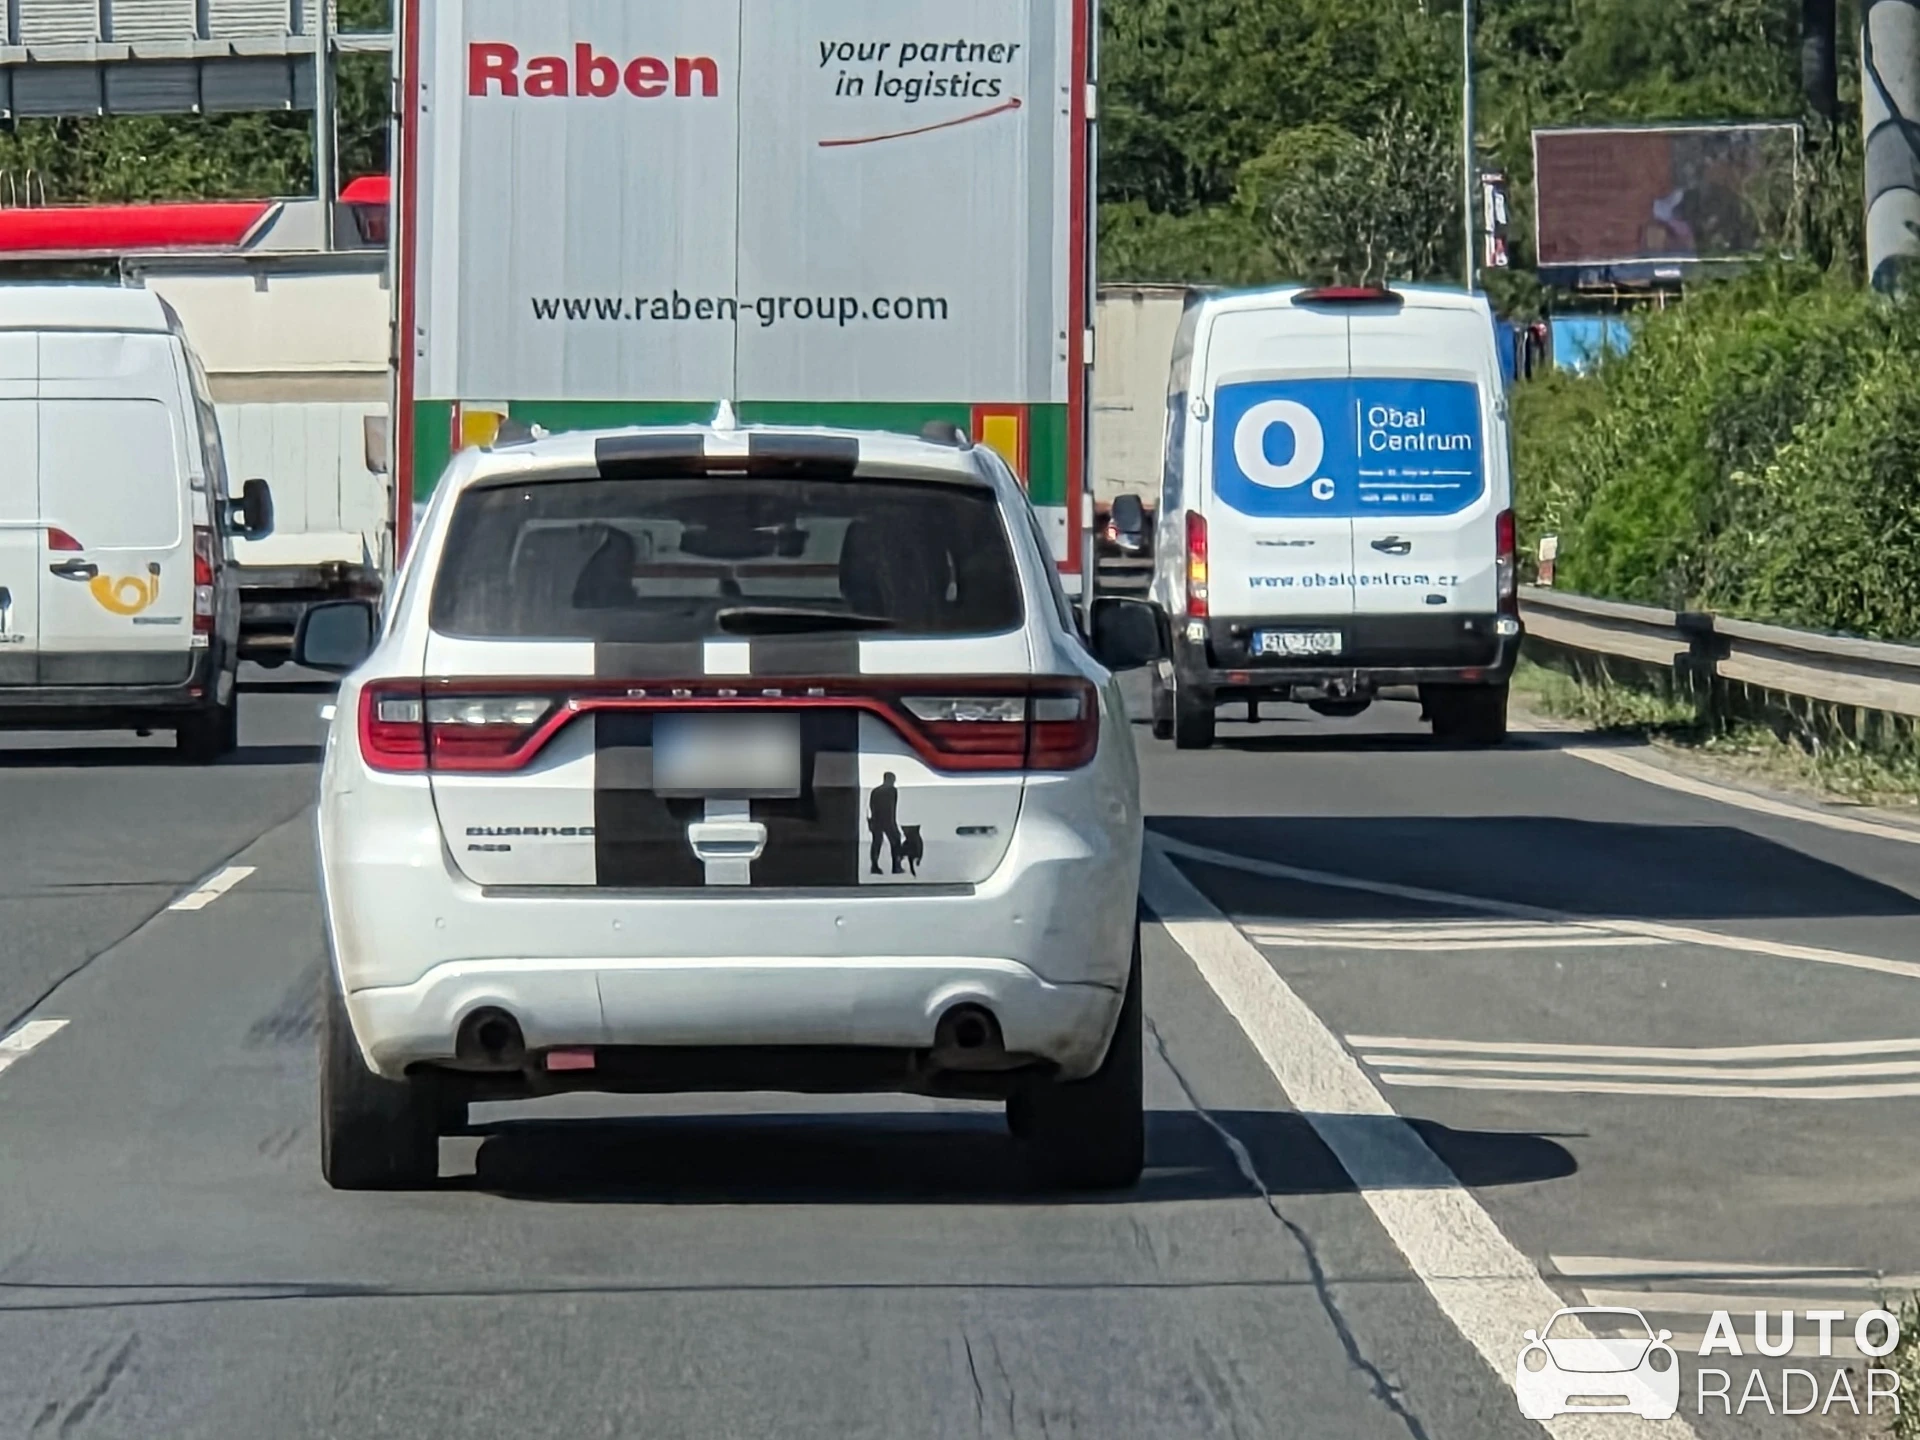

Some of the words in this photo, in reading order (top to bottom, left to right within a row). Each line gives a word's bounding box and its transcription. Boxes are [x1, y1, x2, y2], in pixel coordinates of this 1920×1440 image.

[819, 41, 891, 68] your
[898, 39, 1020, 68] partner
[468, 42, 719, 98] Raben
[835, 70, 864, 97] in
[874, 70, 1002, 103] logistics
[531, 289, 949, 328] www.raben-group.com
[1368, 406, 1426, 428] Obal
[1368, 430, 1472, 452] Centrum
